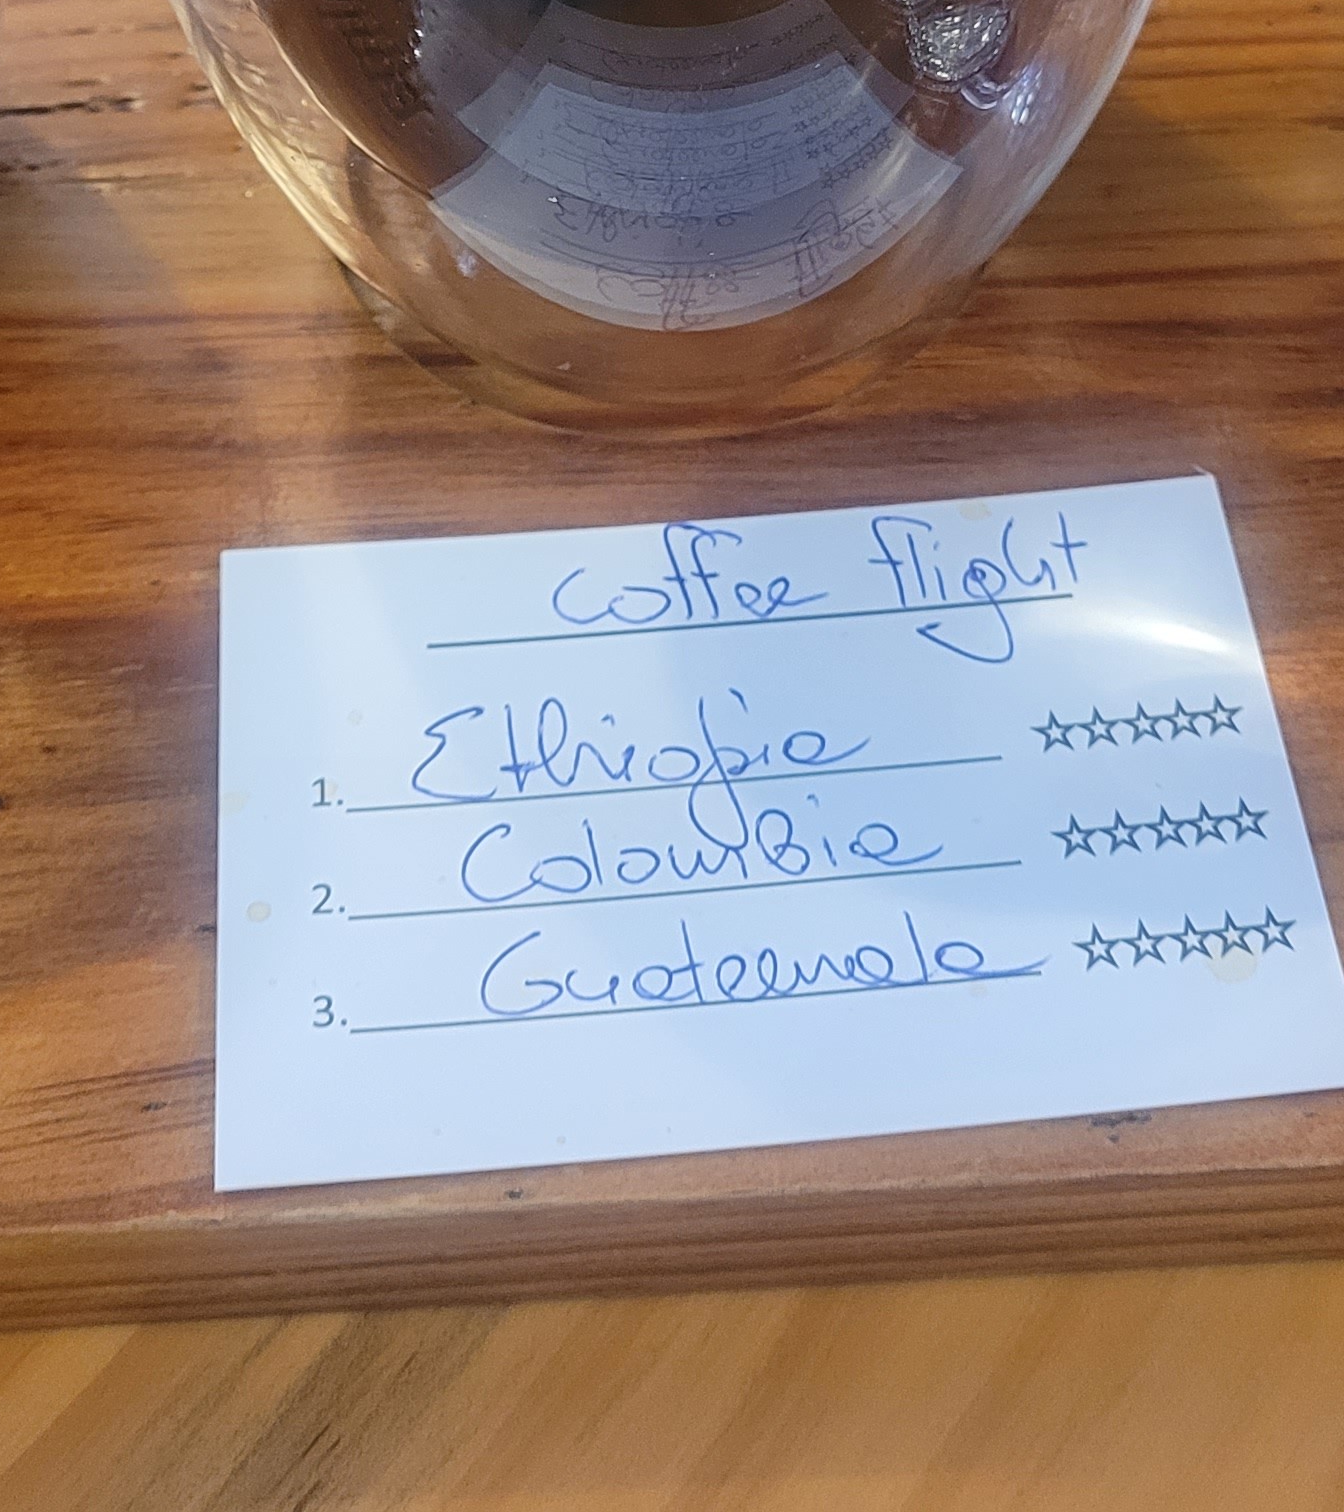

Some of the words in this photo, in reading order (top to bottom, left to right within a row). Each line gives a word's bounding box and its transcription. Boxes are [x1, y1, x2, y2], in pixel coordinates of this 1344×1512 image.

[309, 776, 345, 809] 1.
[410, 687, 872, 850] Ethiopia
[310, 882, 347, 916] 2.
[311, 994, 349, 1030] 3.
